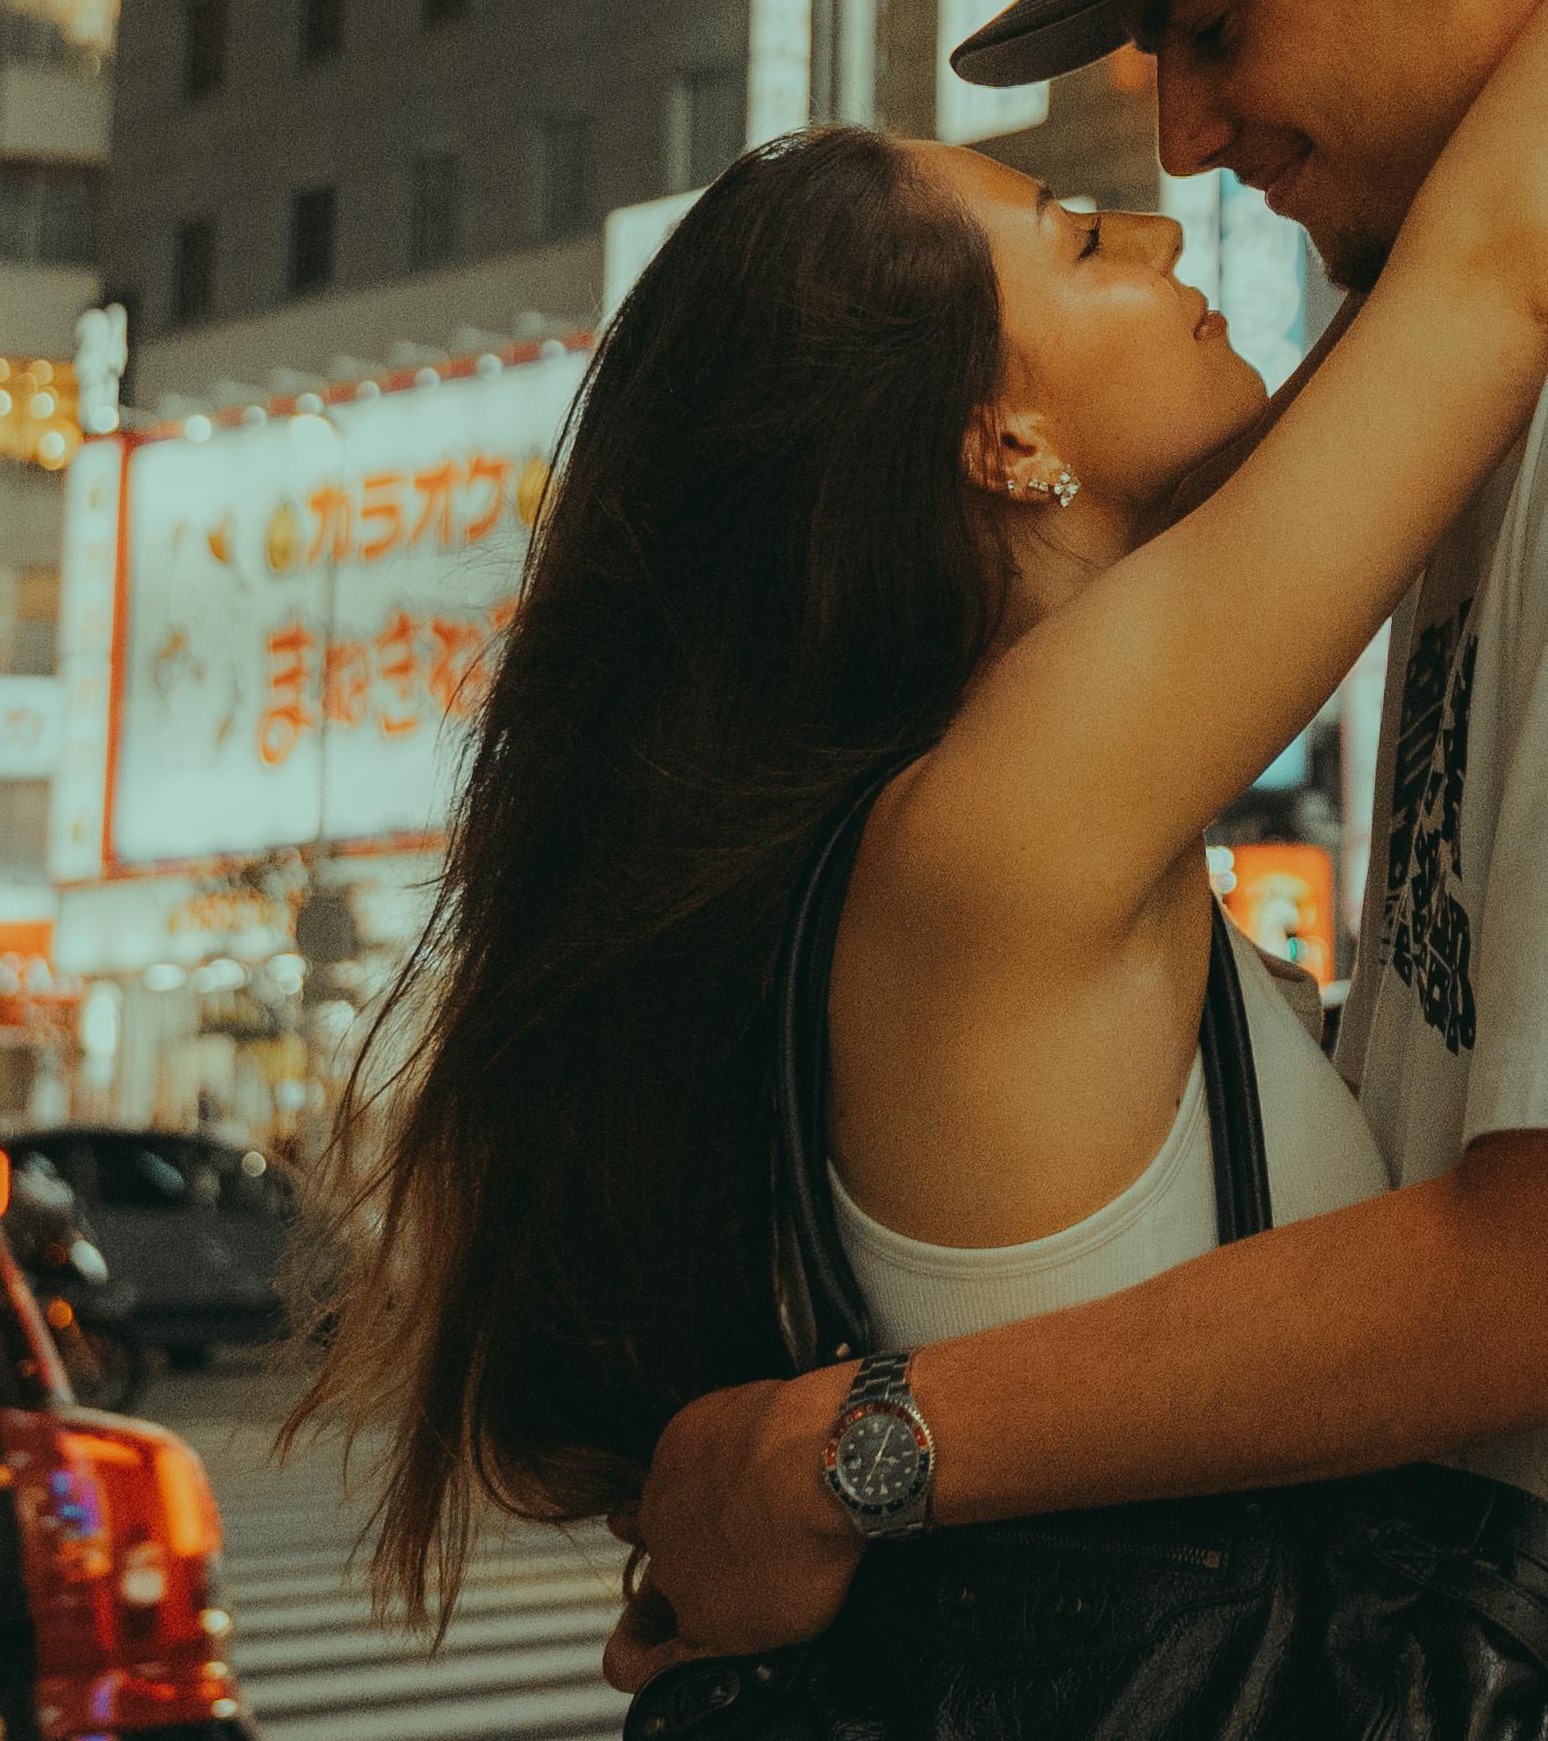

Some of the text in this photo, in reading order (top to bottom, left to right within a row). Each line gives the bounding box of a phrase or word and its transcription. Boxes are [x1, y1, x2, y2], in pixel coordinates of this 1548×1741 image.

[305, 457, 510, 562] カラオケ
[258, 595, 518, 765] まねきね
